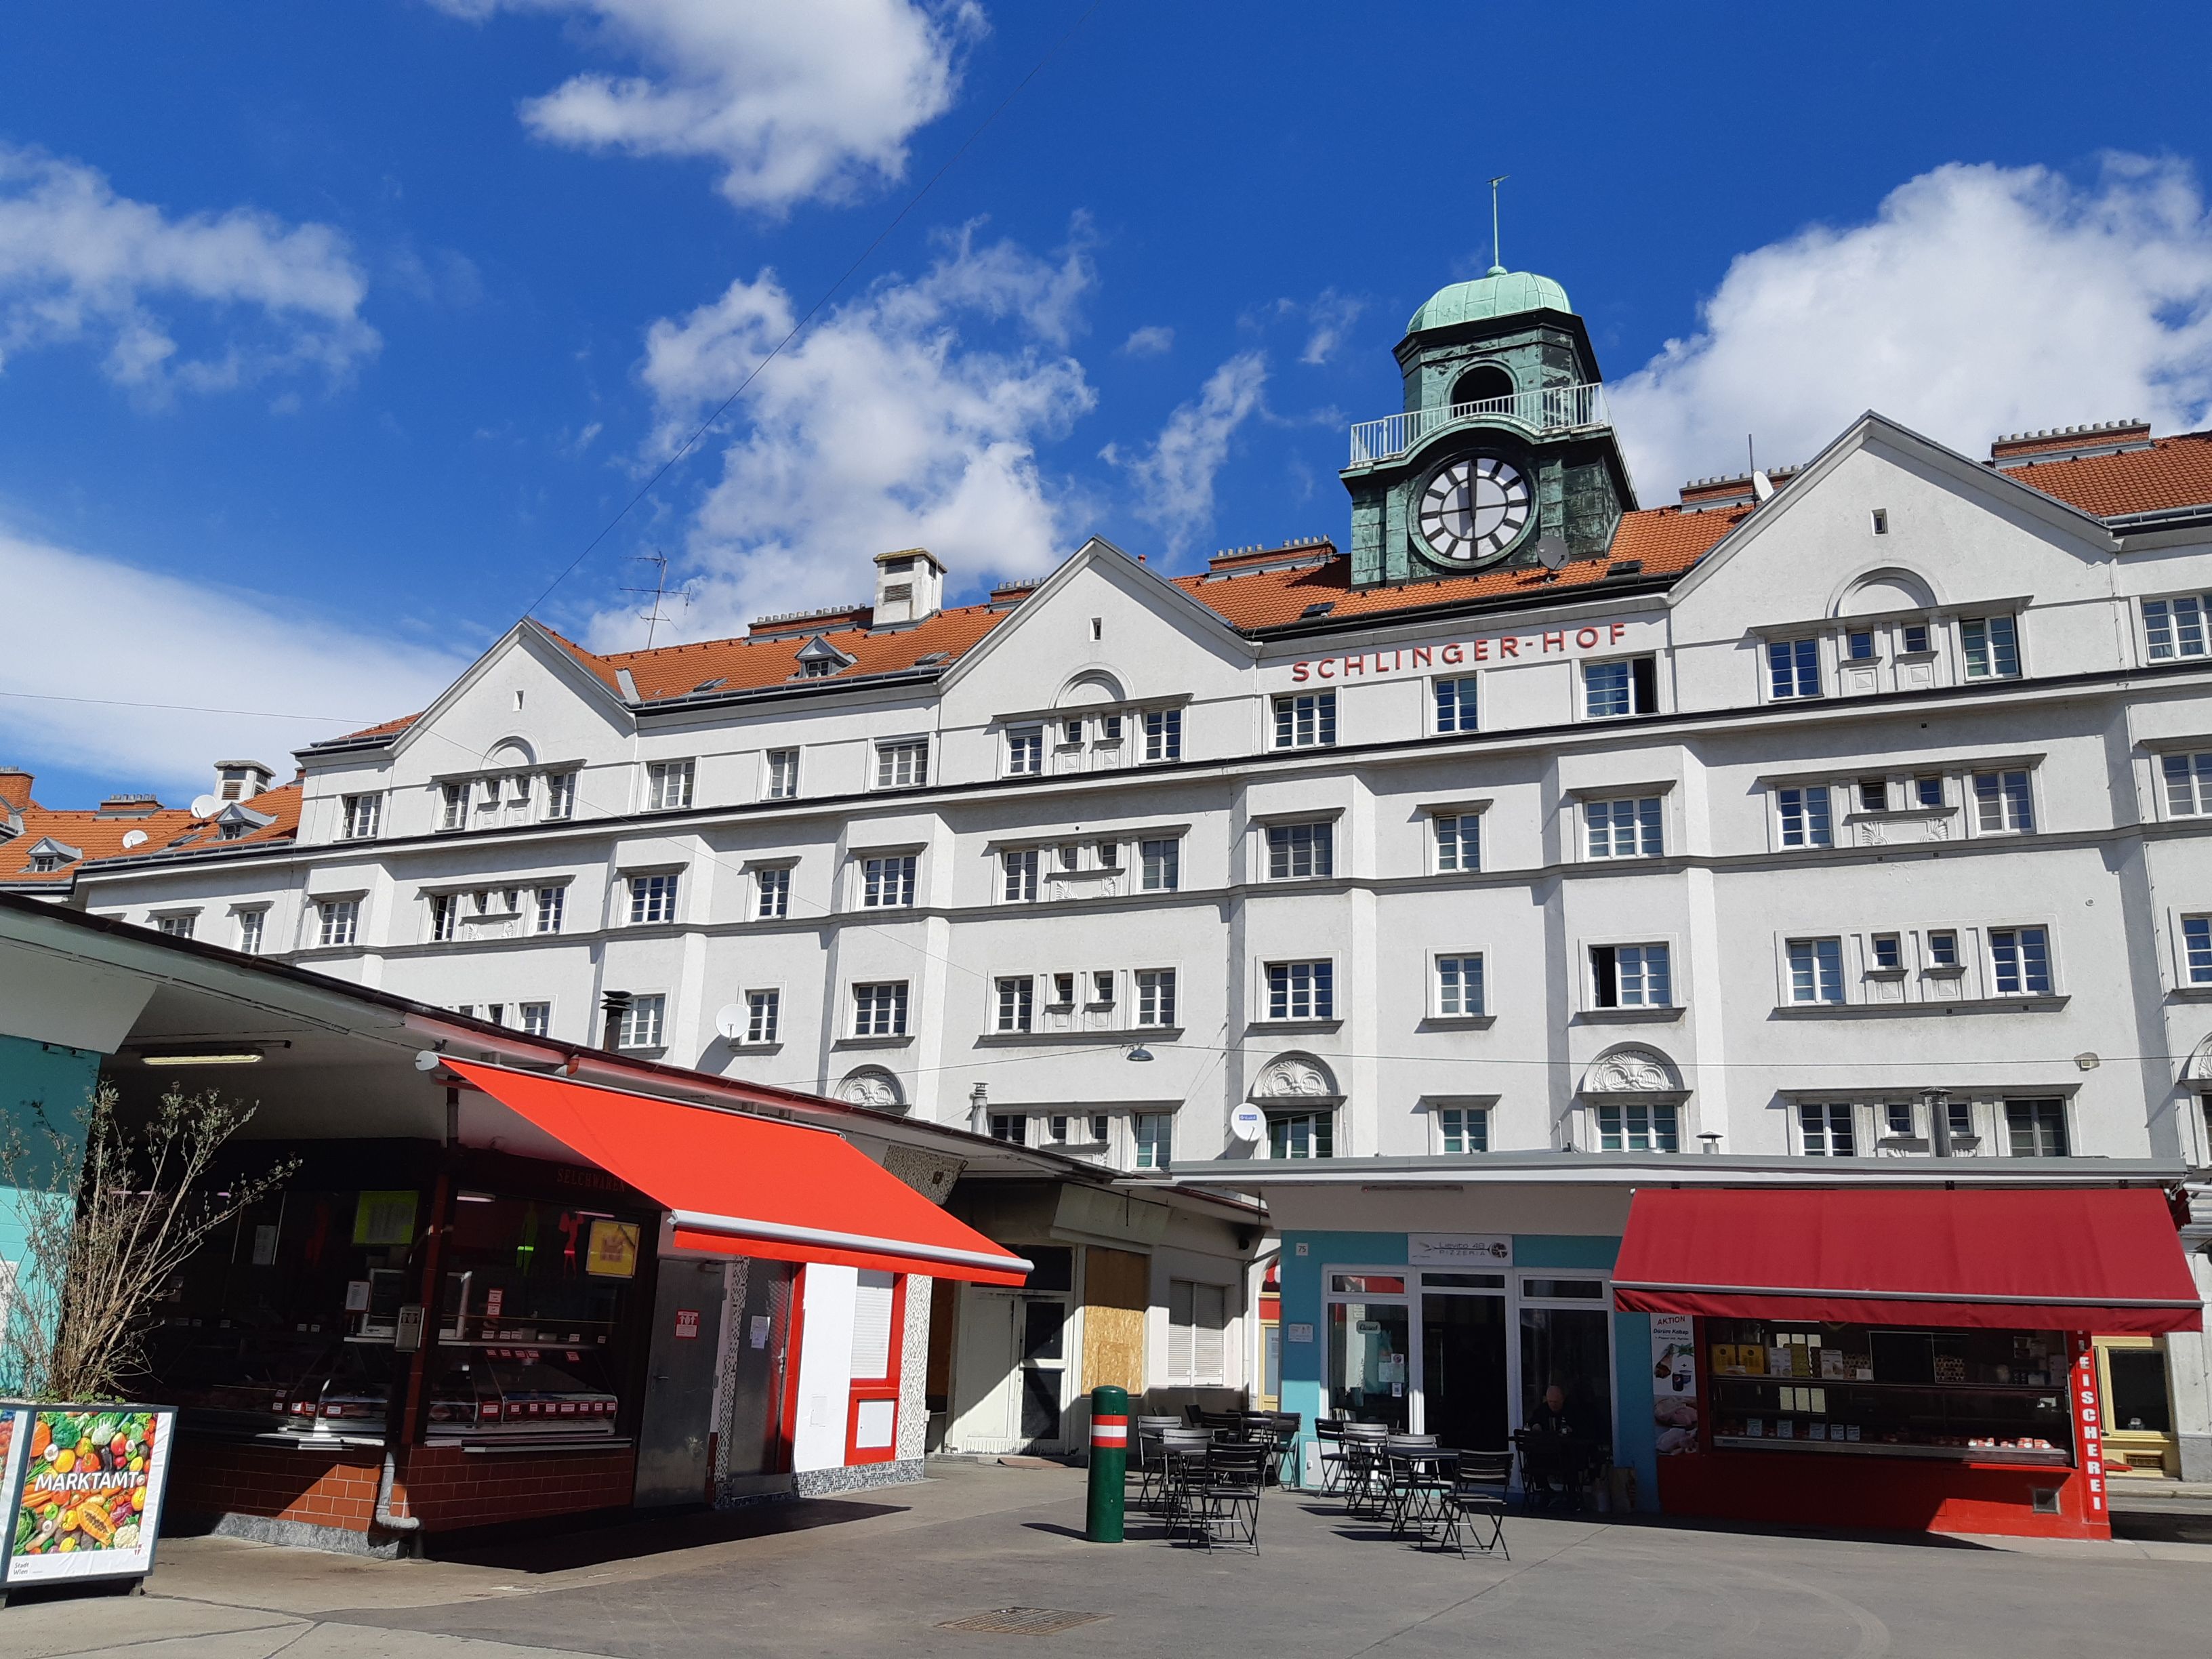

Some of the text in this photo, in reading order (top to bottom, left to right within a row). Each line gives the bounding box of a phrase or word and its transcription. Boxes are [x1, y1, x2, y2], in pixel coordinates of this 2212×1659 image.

[1292, 622, 1626, 682] SCHLINGER-HOF
[557, 1168, 626, 1193] SELCHWAREN
[1298, 1245, 1307, 1253] 75
[1657, 1315, 1685, 1326] AKTION
[35, 1472, 139, 1492] MARKTAMT
